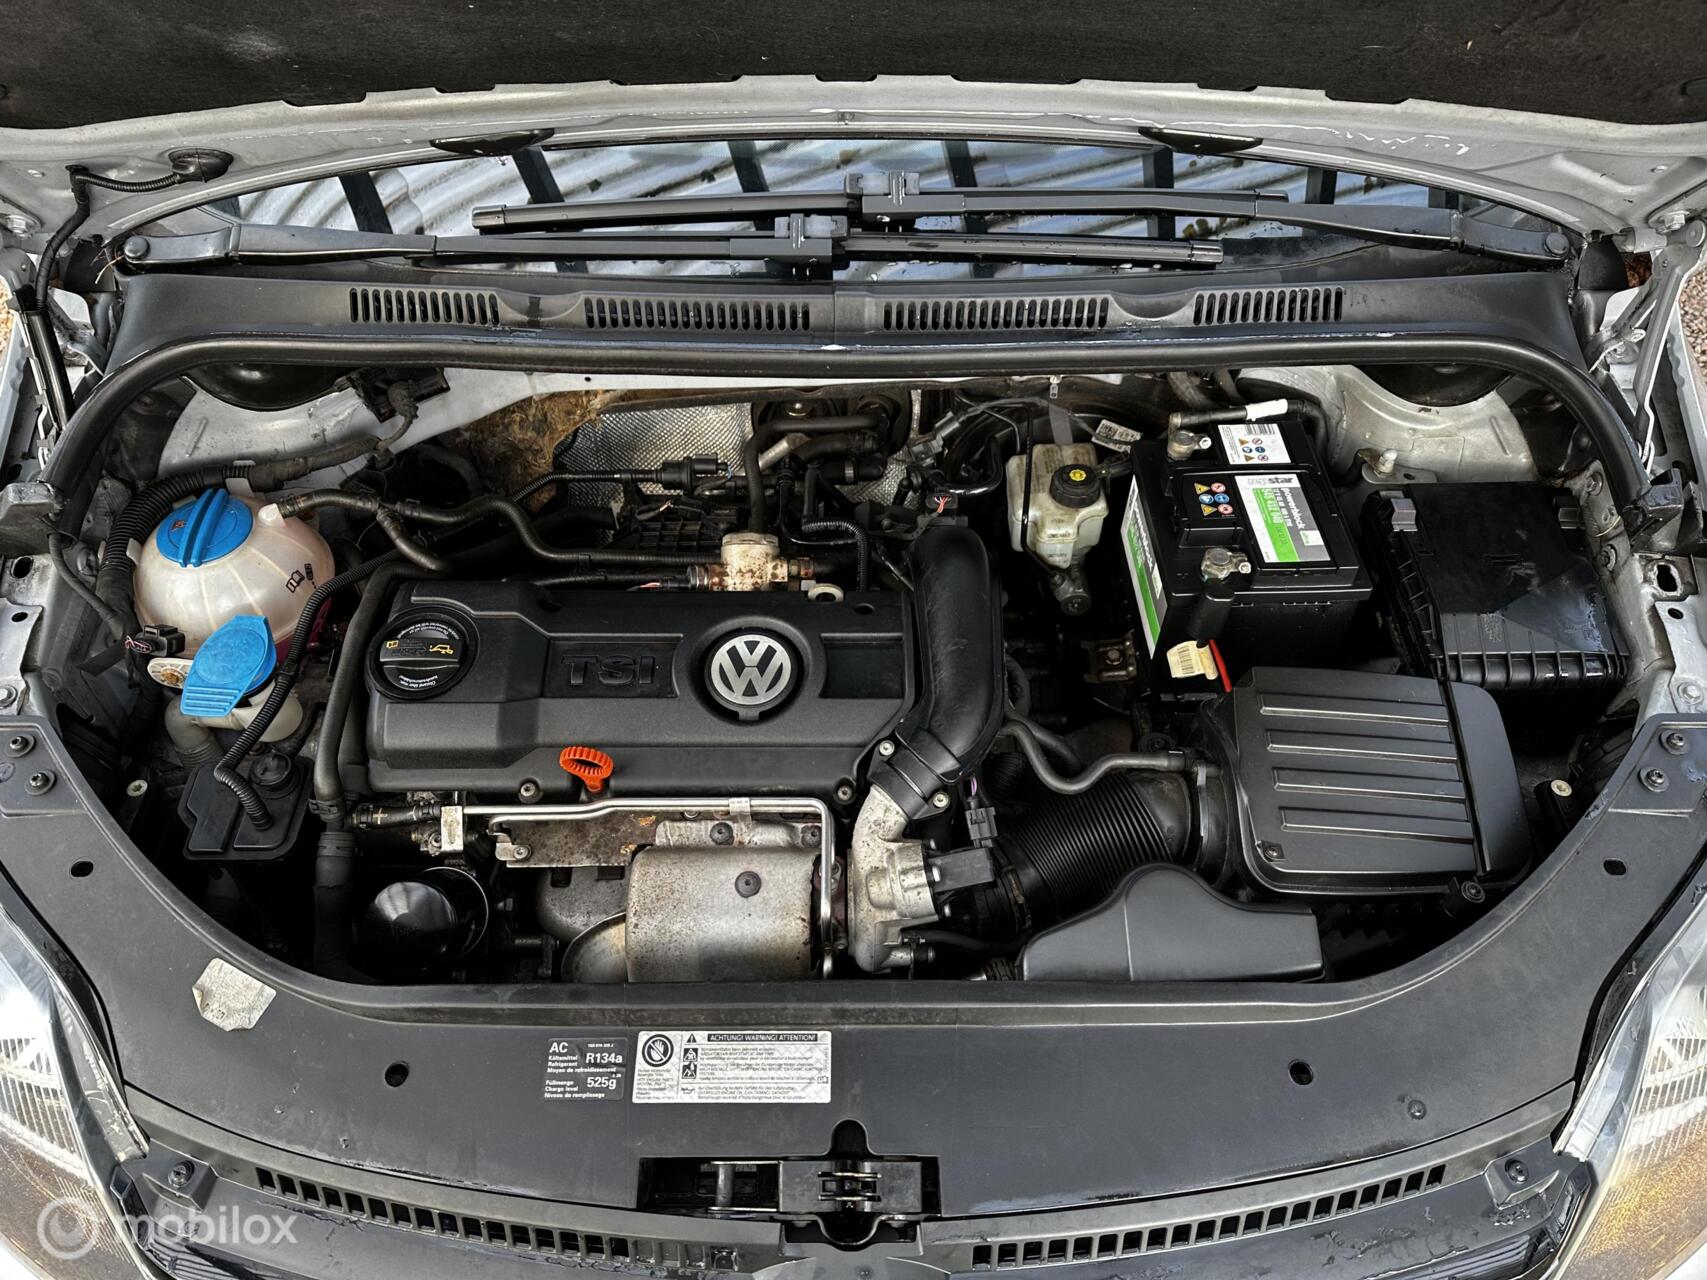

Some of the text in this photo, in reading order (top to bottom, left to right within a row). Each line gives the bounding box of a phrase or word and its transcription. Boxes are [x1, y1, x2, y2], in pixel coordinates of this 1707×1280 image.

[1280, 488, 1306, 529] powerblock
[561, 655, 656, 686] TSI
[549, 1042, 568, 1053] AC
[586, 1053, 623, 1063] R134a
[587, 1076, 617, 1090] 525g
